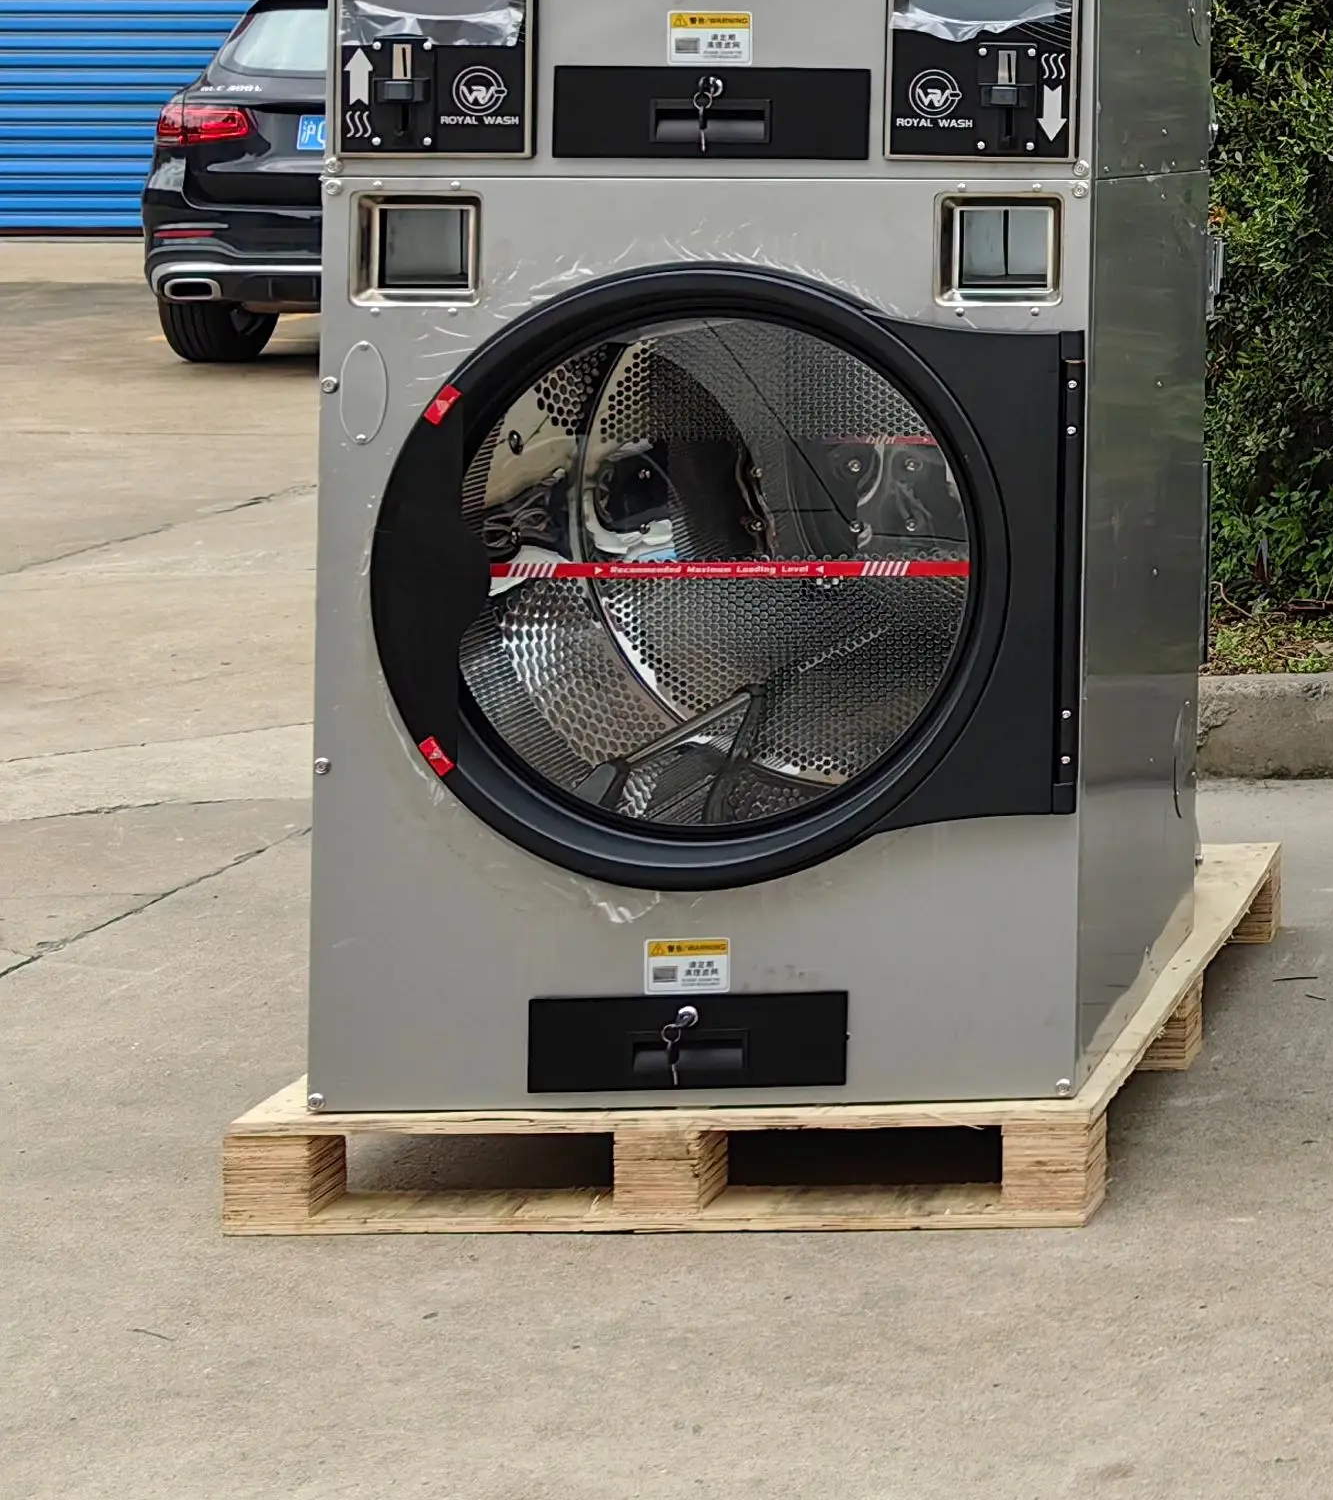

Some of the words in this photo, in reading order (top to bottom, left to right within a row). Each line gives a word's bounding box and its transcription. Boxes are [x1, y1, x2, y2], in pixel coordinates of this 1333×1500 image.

[440, 115, 478, 125] ROYAL
[483, 115, 519, 125] WASH
[896, 118, 933, 128] ROYAL
[938, 118, 974, 129] WASH
[609, 565, 682, 574] Recommended
[687, 565, 732, 573] Maximum
[736, 565, 777, 575] Loading
[781, 565, 809, 573] Level
